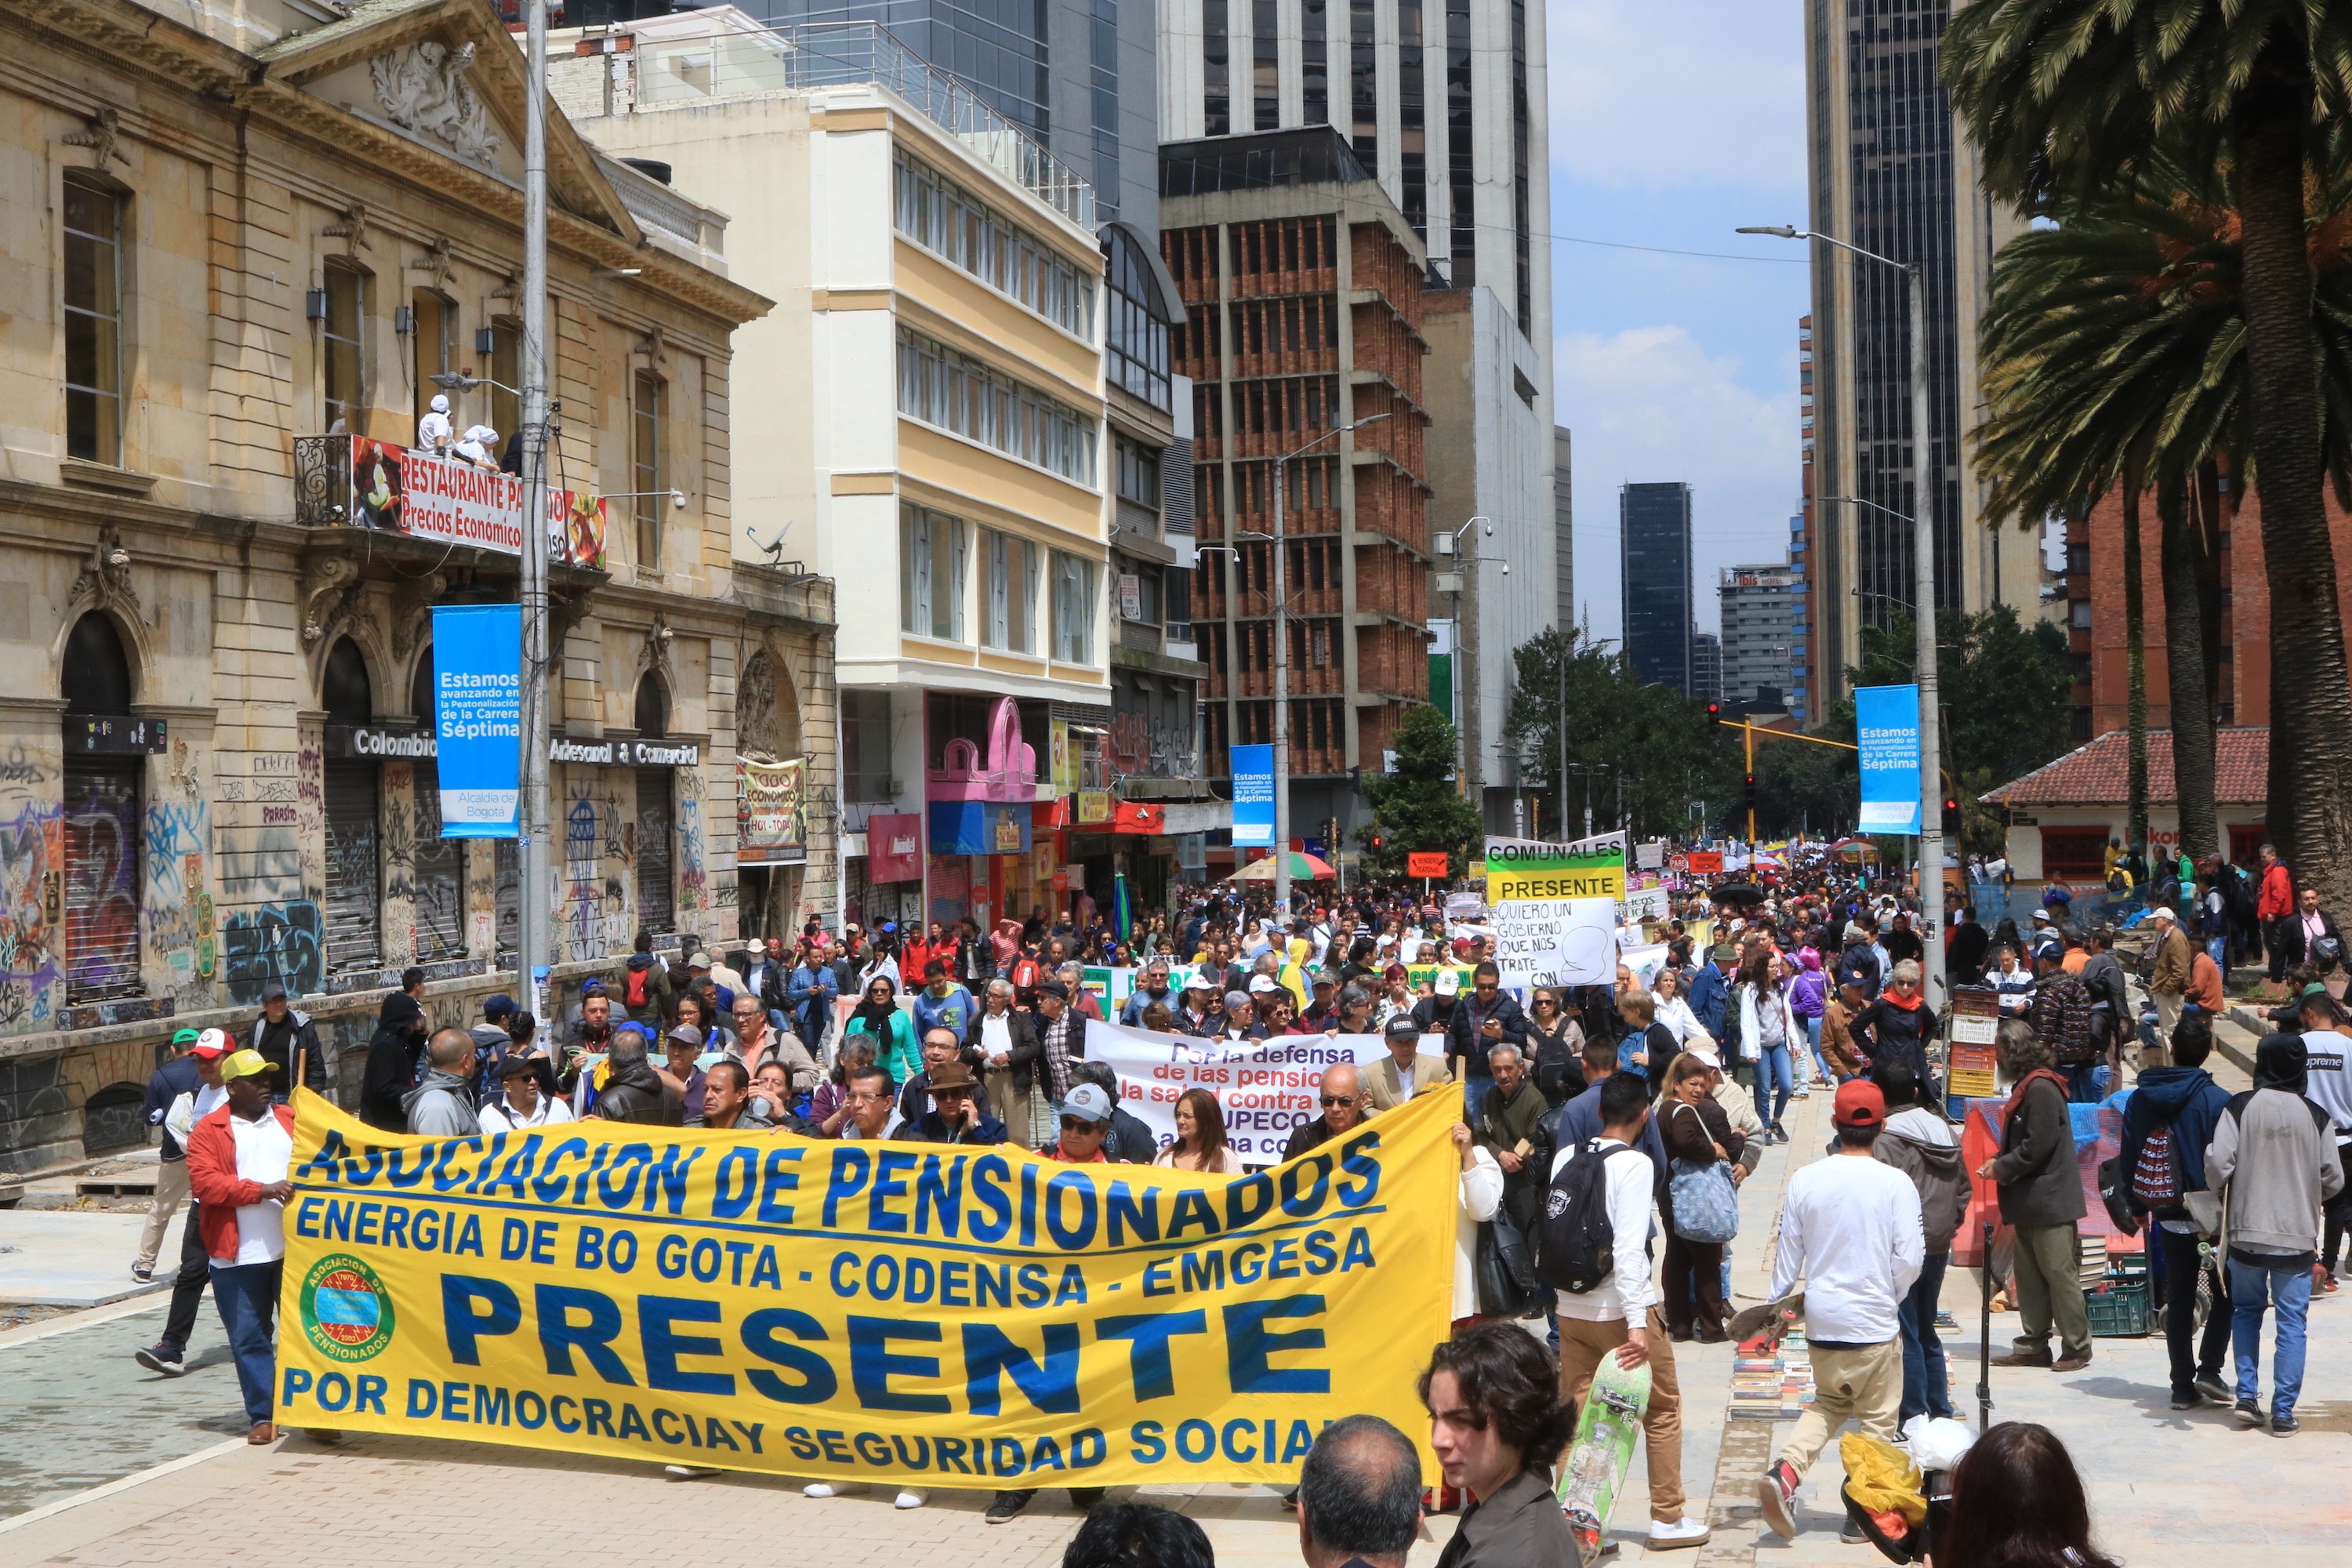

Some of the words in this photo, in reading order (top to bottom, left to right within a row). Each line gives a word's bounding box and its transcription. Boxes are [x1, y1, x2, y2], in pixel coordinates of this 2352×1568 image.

[401, 454, 504, 510] RESTAURANTE
[401, 495, 452, 535] Precios
[456, 507, 523, 548] Económico
[1739, 575, 1758, 586] ibis
[441, 672, 519, 688] Estamos
[441, 688, 503, 699] avanzando
[506, 689, 519, 698] en
[451, 699, 519, 709] Peatonalización
[441, 710, 457, 719] de
[462, 710, 472, 719] la
[477, 709, 519, 719] Carrera
[441, 720, 520, 740] Séptima
[1860, 728, 1916, 739] Estamos
[549, 739, 612, 764] Artesanal
[635, 743, 698, 765] Comercial
[1862, 757, 1918, 771] Séptima
[750, 772, 792, 788] TODO
[459, 792, 499, 804] Alcaldía
[501, 792, 514, 803] de
[1235, 794, 1272, 804] Séptima
[466, 806, 505, 819] Bogotá
[1872, 804, 1902, 812] Alcaldía
[1878, 812, 1906, 821] Bogotá
[751, 819, 767, 831] HOY
[772, 818, 794, 831] TODAY
[1489, 839, 1622, 862] COMUNALES
[1502, 877, 1614, 898] PRESENTE
[1615, 895, 1655, 908] BLICOS
[1498, 902, 1550, 924] QUIERO
[1554, 902, 1572, 918] UN
[1497, 920, 1562, 938] GOBIERNO
[1500, 939, 1529, 958] QUE
[1533, 937, 1556, 952] NOS
[1498, 957, 1538, 972] TRATE
[1531, 971, 1558, 988] CON
[1171, 1042, 1218, 1065] Por
[1223, 1049, 1244, 1064] la
[1259, 1045, 1355, 1065] defensa
[2306, 1058, 2343, 1069] upreme
[1153, 1063, 1185, 1080] de
[1193, 1065, 1230, 1083] las
[1237, 1067, 1321, 1089] pensio
[1121, 1080, 1142, 1101] la
[1228, 1091, 1312, 1110] contra
[296, 1128, 705, 1214] ASOCIACION
[712, 1145, 808, 1224] DE
[822, 1131, 1382, 1251] PENSIONADOS
[296, 1196, 485, 1258] ENERGIA
[501, 1218, 559, 1265] DE
[575, 1225, 638, 1273] BO
[656, 1233, 782, 1290] GOTA
[829, 1250, 1088, 1308] CODENSA
[1142, 1226, 1376, 1298] EMGESA
[308, 1258, 368, 1288] ASOCIACION
[372, 1278, 385, 1295] DE
[309, 1325, 388, 1359] PENSIONADOS
[440, 1272, 1331, 1417] PRESENTE
[281, 1367, 389, 1416] POR
[405, 1377, 769, 1455] DEMOCRACIAY
[785, 1425, 1107, 1478] SEGURIDAD
[1130, 1417, 1333, 1465] SOCIA
